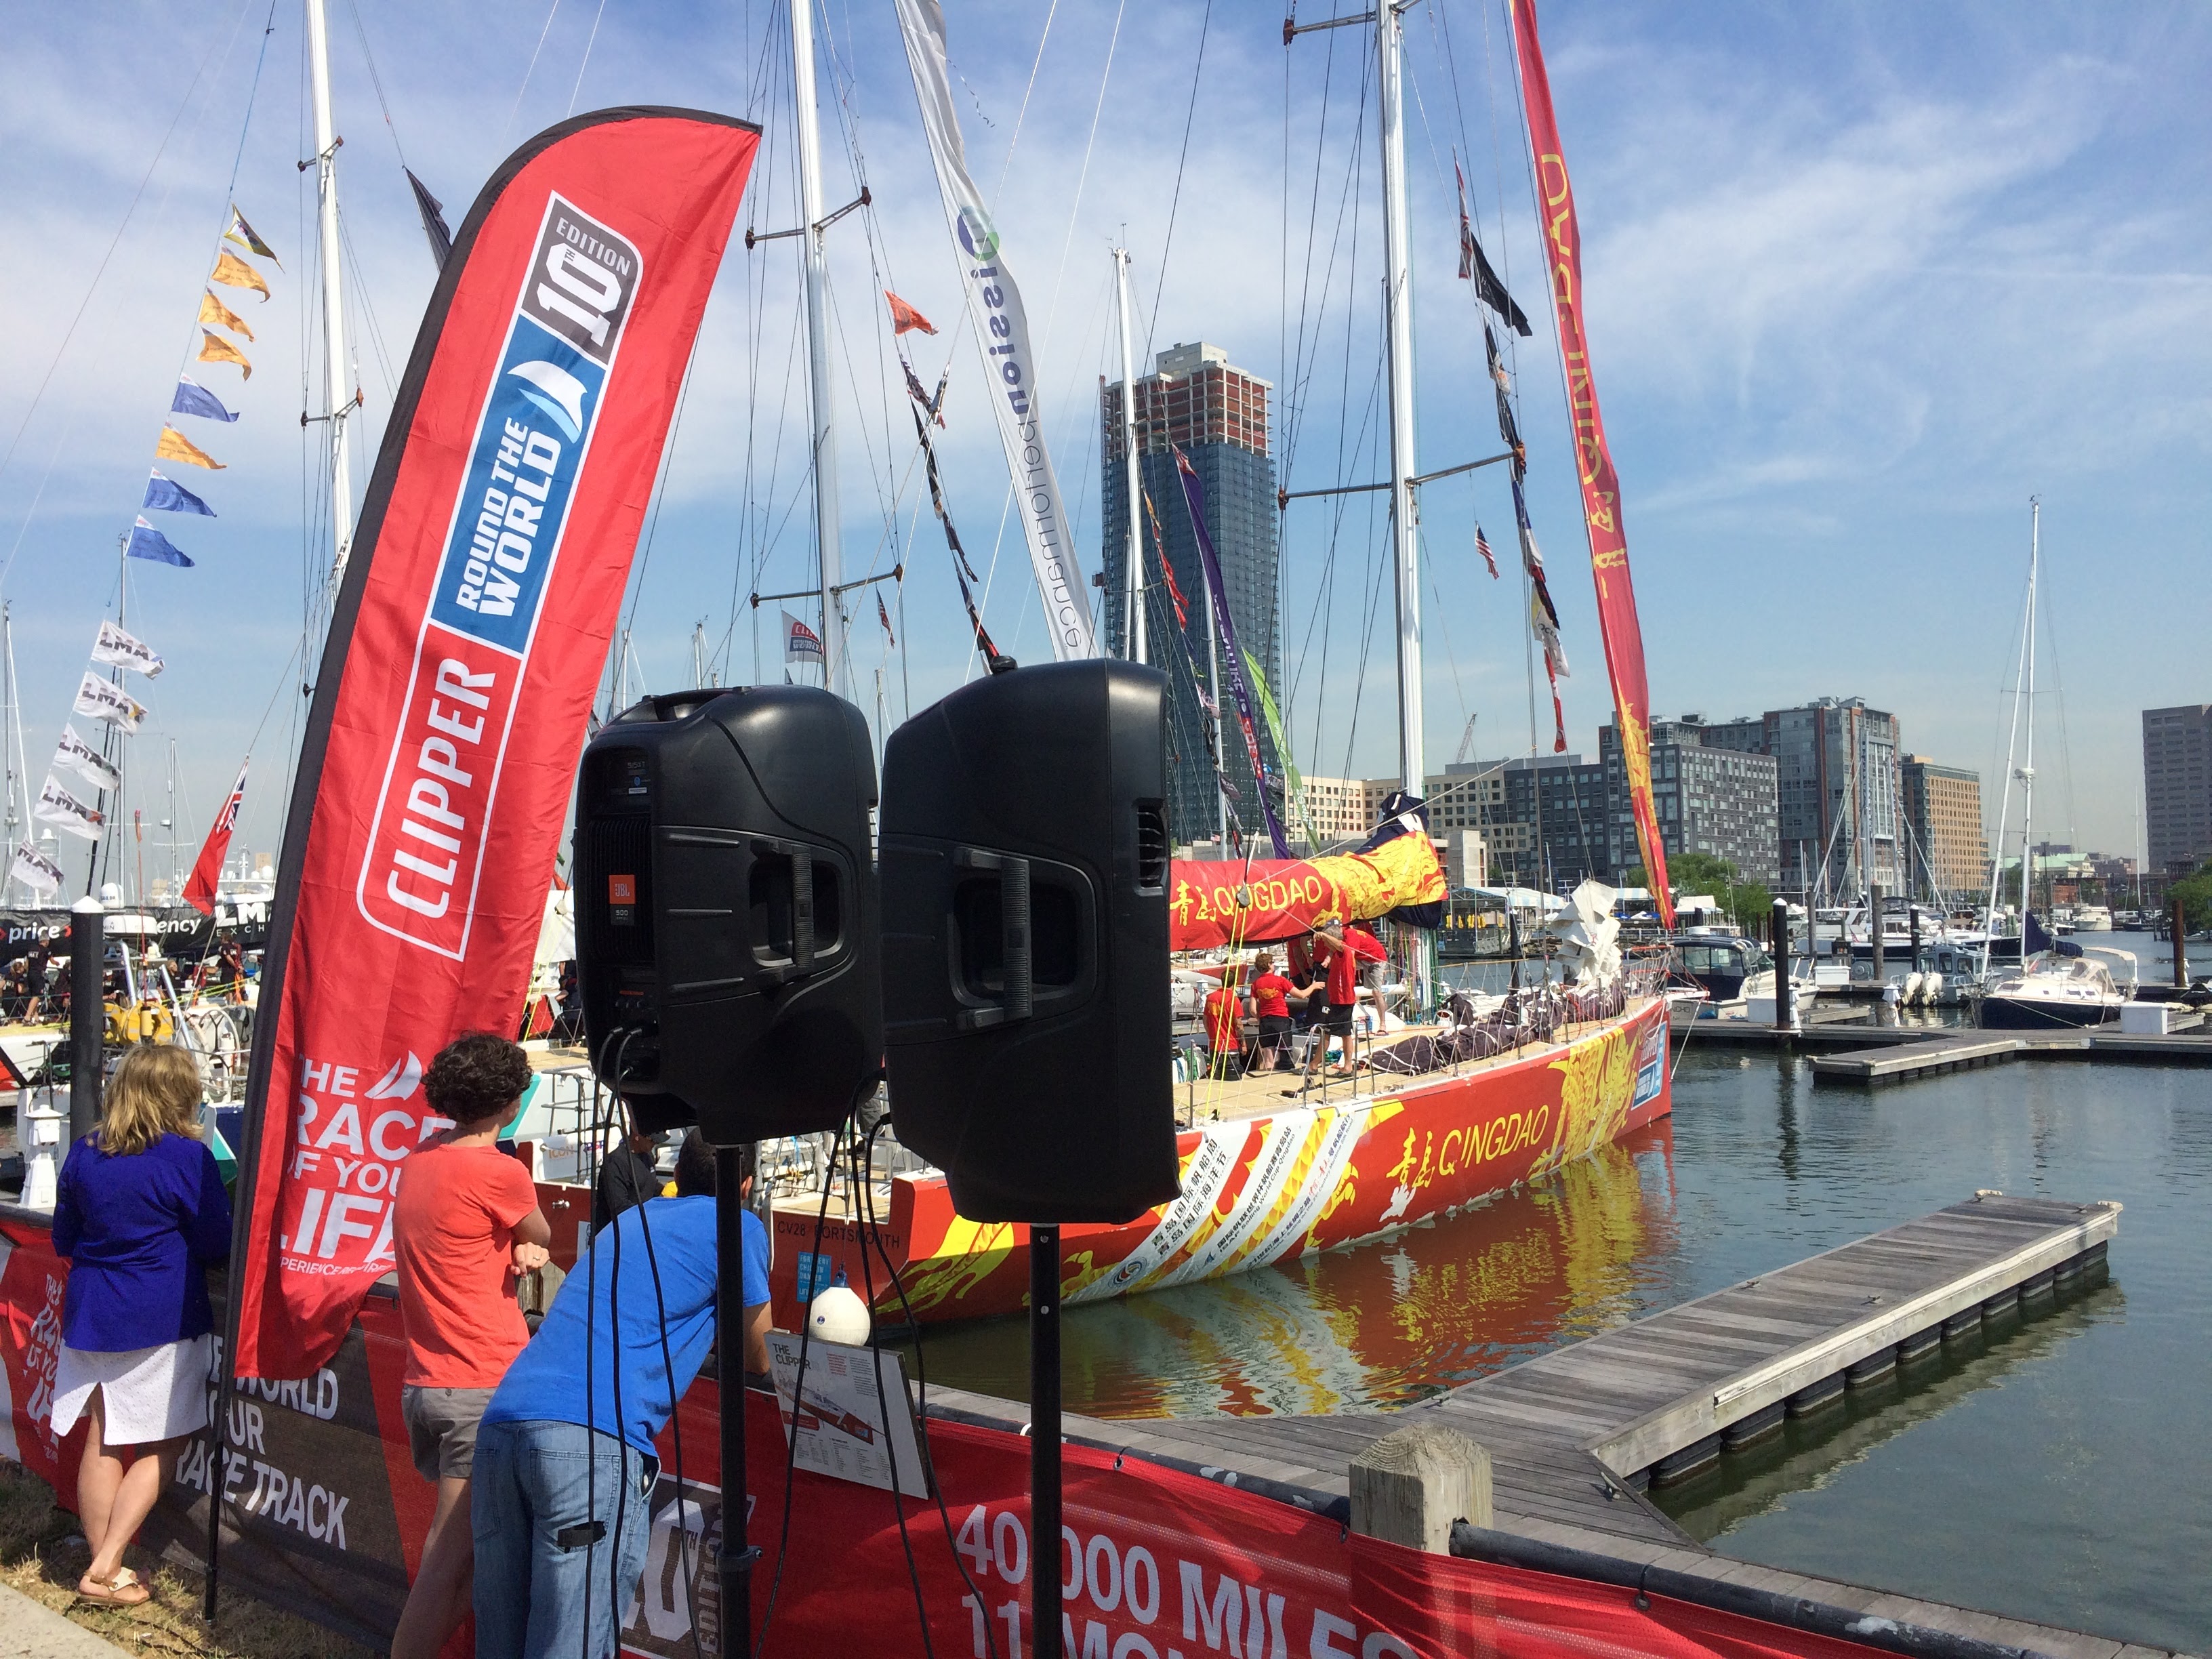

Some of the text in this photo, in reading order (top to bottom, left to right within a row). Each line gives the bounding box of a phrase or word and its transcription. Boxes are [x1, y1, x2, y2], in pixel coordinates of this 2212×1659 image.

[556, 217, 631, 276] EDITION
[537, 242, 622, 348] 10
[1540, 153, 1601, 485] QINDAO
[456, 416, 529, 611] ROUND THE
[478, 431, 562, 617] WORLD
[387, 658, 496, 918] CLIPPER
[214, 902, 271, 928] LM
[615, 883, 630, 897] JBL
[1214, 876, 1322, 916] QINGDAO
[8, 922, 61, 944] price
[299, 1054, 360, 1099] HE
[287, 1145, 319, 1181] F
[1259, 1184, 1272, 1206] World
[1271, 1166, 1280, 1182] Cup
[1278, 1133, 1295, 1166] Qingdao
[1439, 1105, 1549, 1176] QINGDAO
[777, 1221, 900, 1248] CV28 ORTSOTH
[800, 1272, 822, 1282] DANER
[773, 1343, 790, 1355] THE
[209, 1390, 266, 1456] UR
[245, 1460, 350, 1551] TRACK
